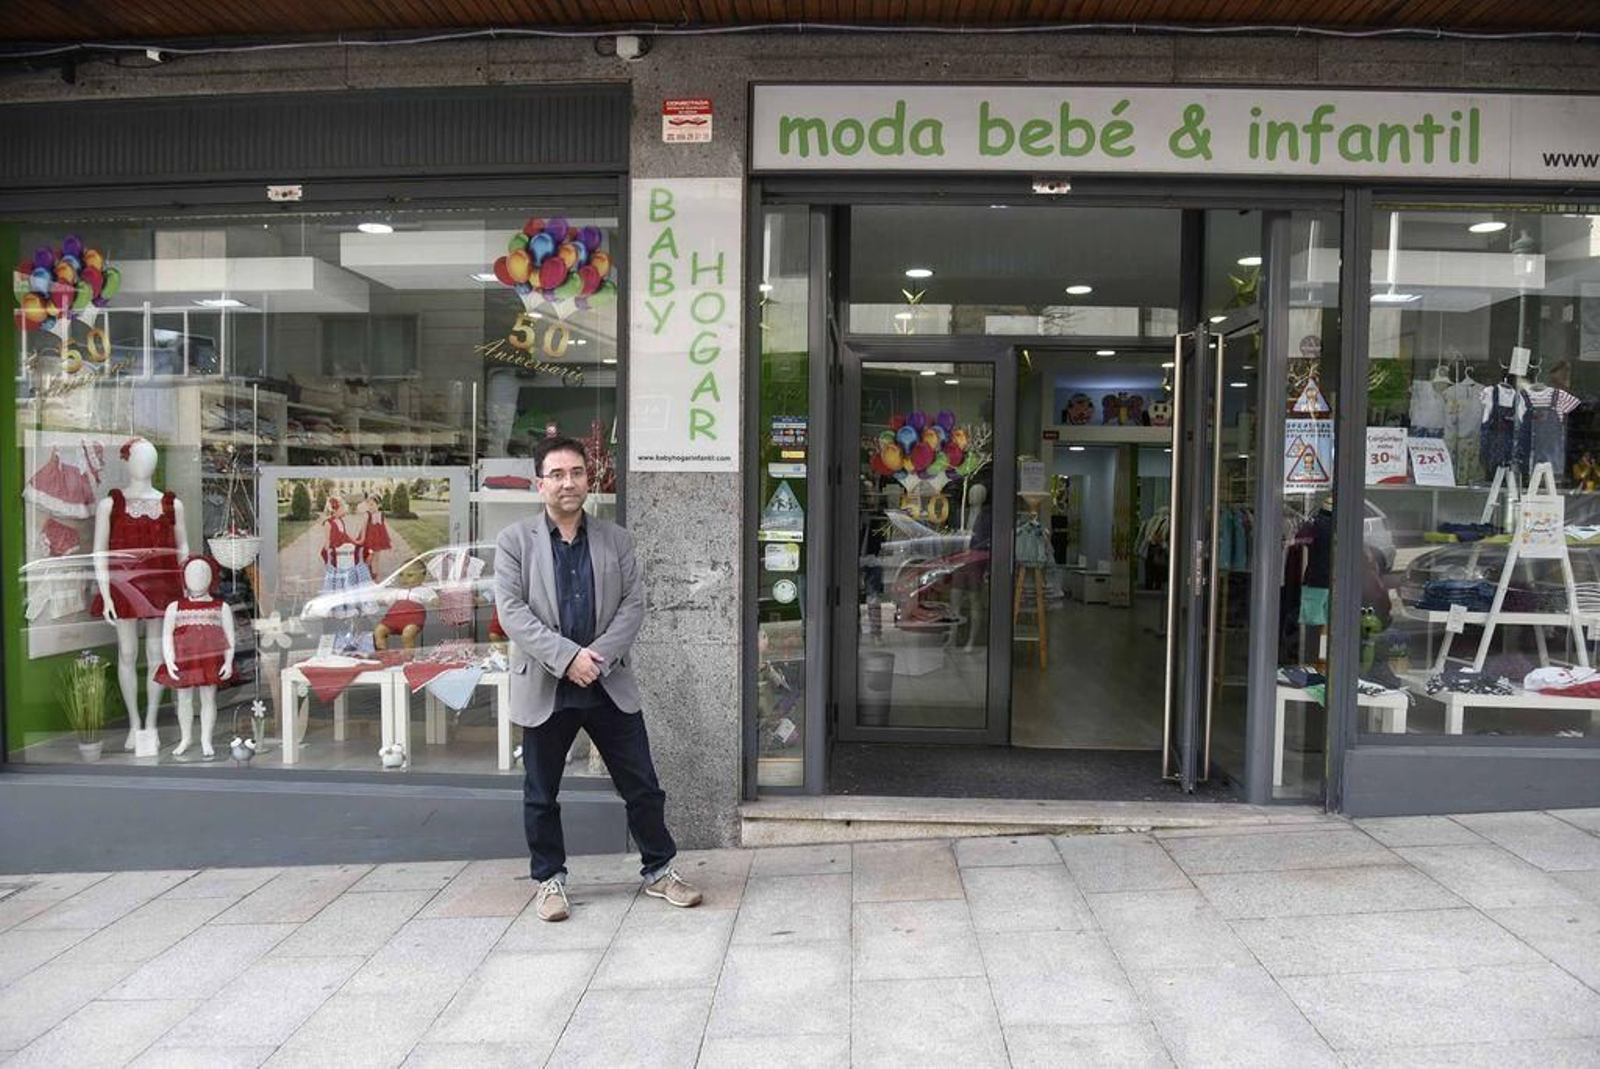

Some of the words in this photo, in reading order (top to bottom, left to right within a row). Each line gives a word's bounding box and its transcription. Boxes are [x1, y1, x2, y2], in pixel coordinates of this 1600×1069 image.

[779, 99, 945, 158] moda
[978, 99, 1135, 158] bebé
[1168, 103, 1213, 162] &
[1248, 105, 1480, 165] infantil
[645, 188, 679, 334] BABY
[508, 312, 569, 358] 50
[689, 252, 725, 441] HOGAR
[637, 454, 732, 463] www.babyhogarinfantil.com
[1417, 452, 1445, 465] 2x1
